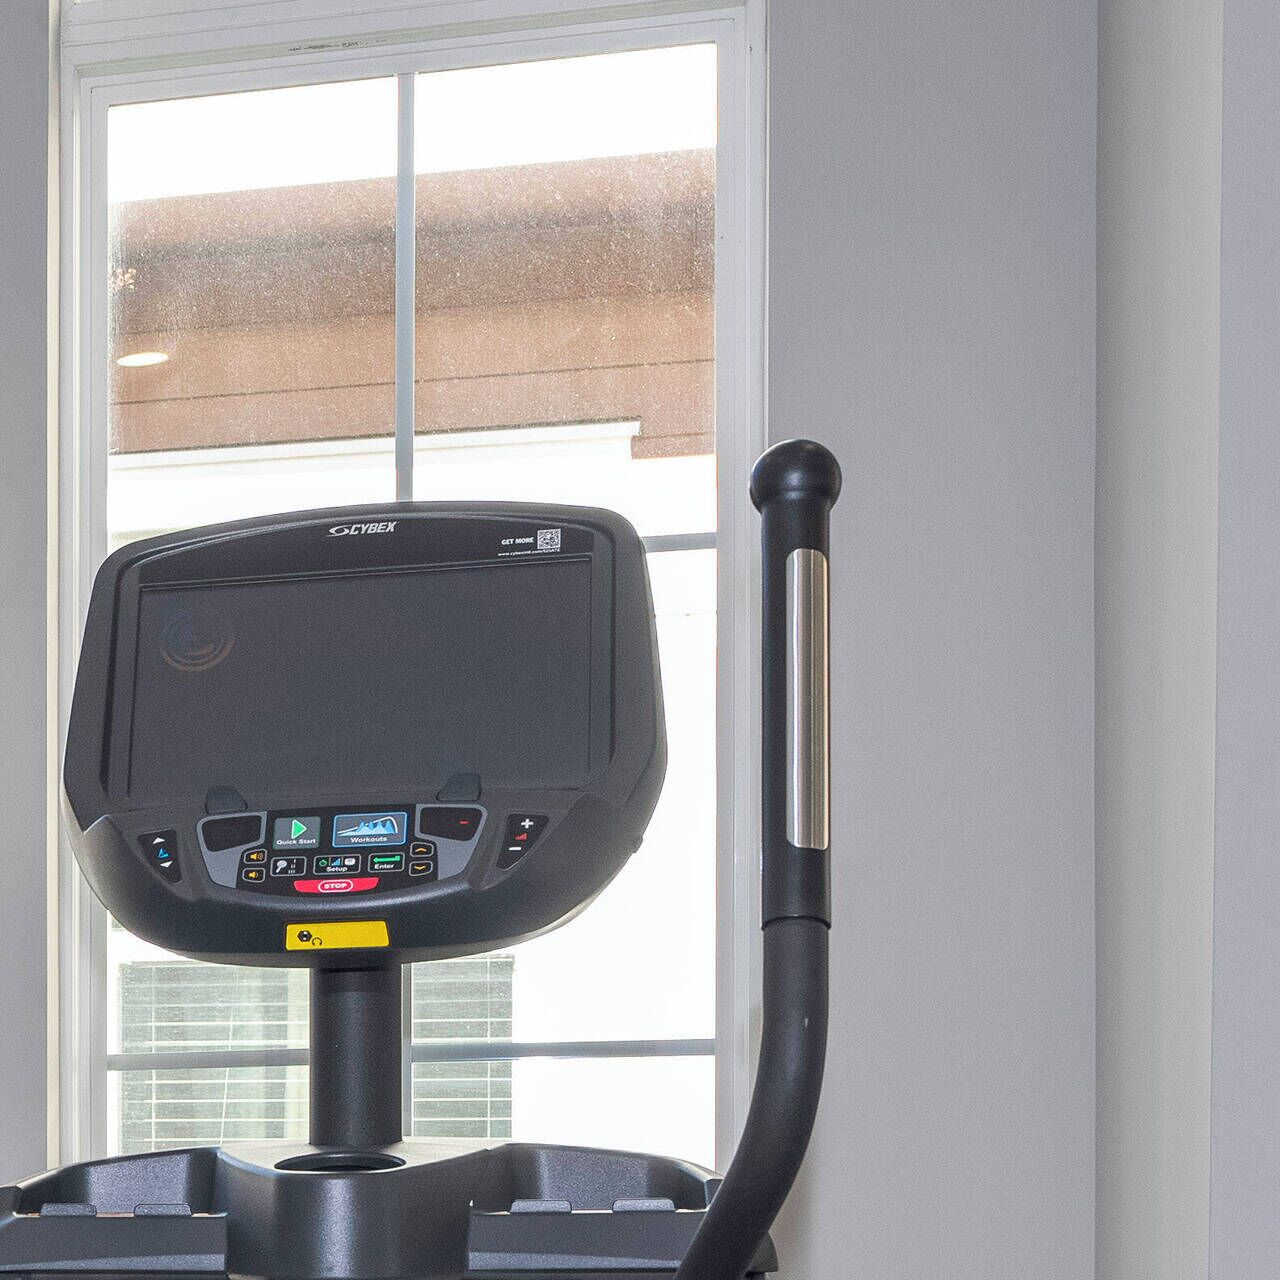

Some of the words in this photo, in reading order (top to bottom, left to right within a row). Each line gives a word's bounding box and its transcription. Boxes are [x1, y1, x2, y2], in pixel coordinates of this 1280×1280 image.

[348, 521, 397, 536] CYBEX
[515, 537, 535, 545] MORE
[350, 835, 388, 843] Workouts
